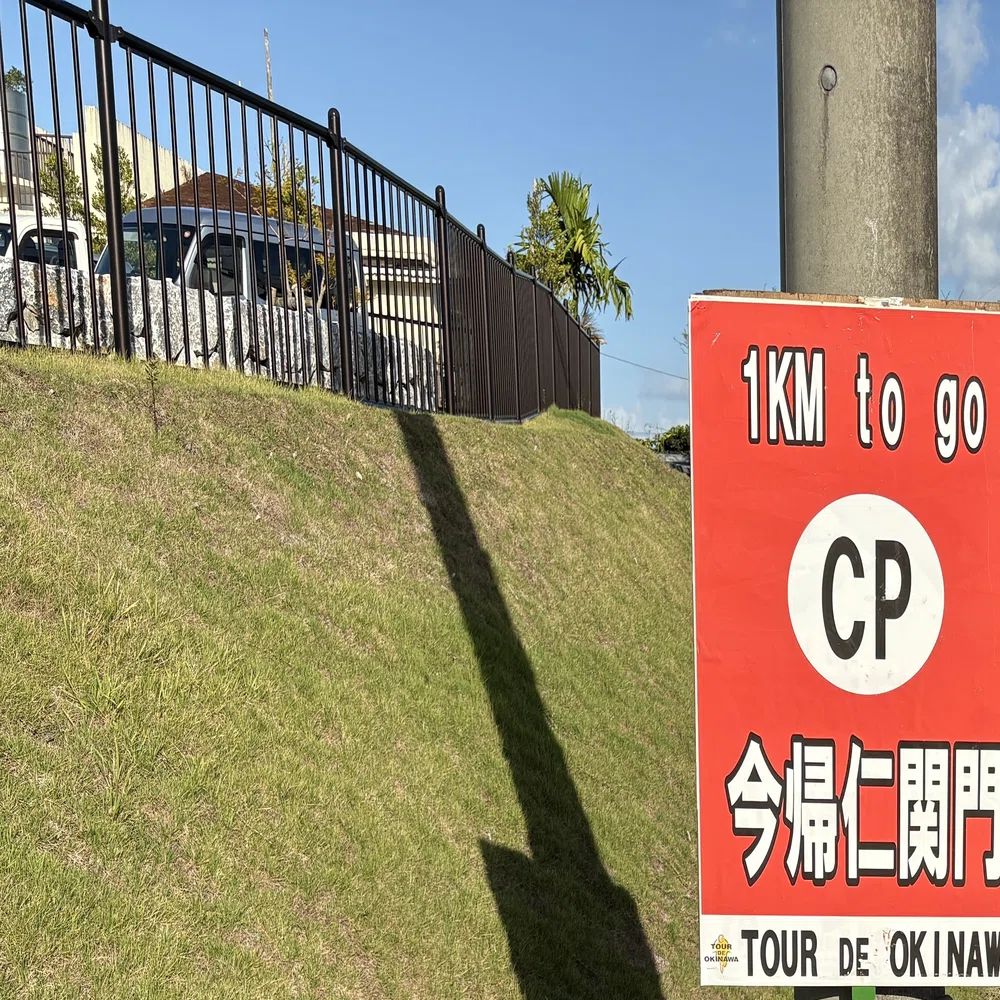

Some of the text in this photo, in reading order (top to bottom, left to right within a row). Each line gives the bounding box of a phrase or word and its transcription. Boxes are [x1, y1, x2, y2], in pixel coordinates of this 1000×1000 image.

[855, 352, 905, 450] to
[934, 373, 987, 463] go
[821, 535, 912, 660] CP
[741, 929, 818, 977] TOUR
[839, 937, 870, 977] DE
